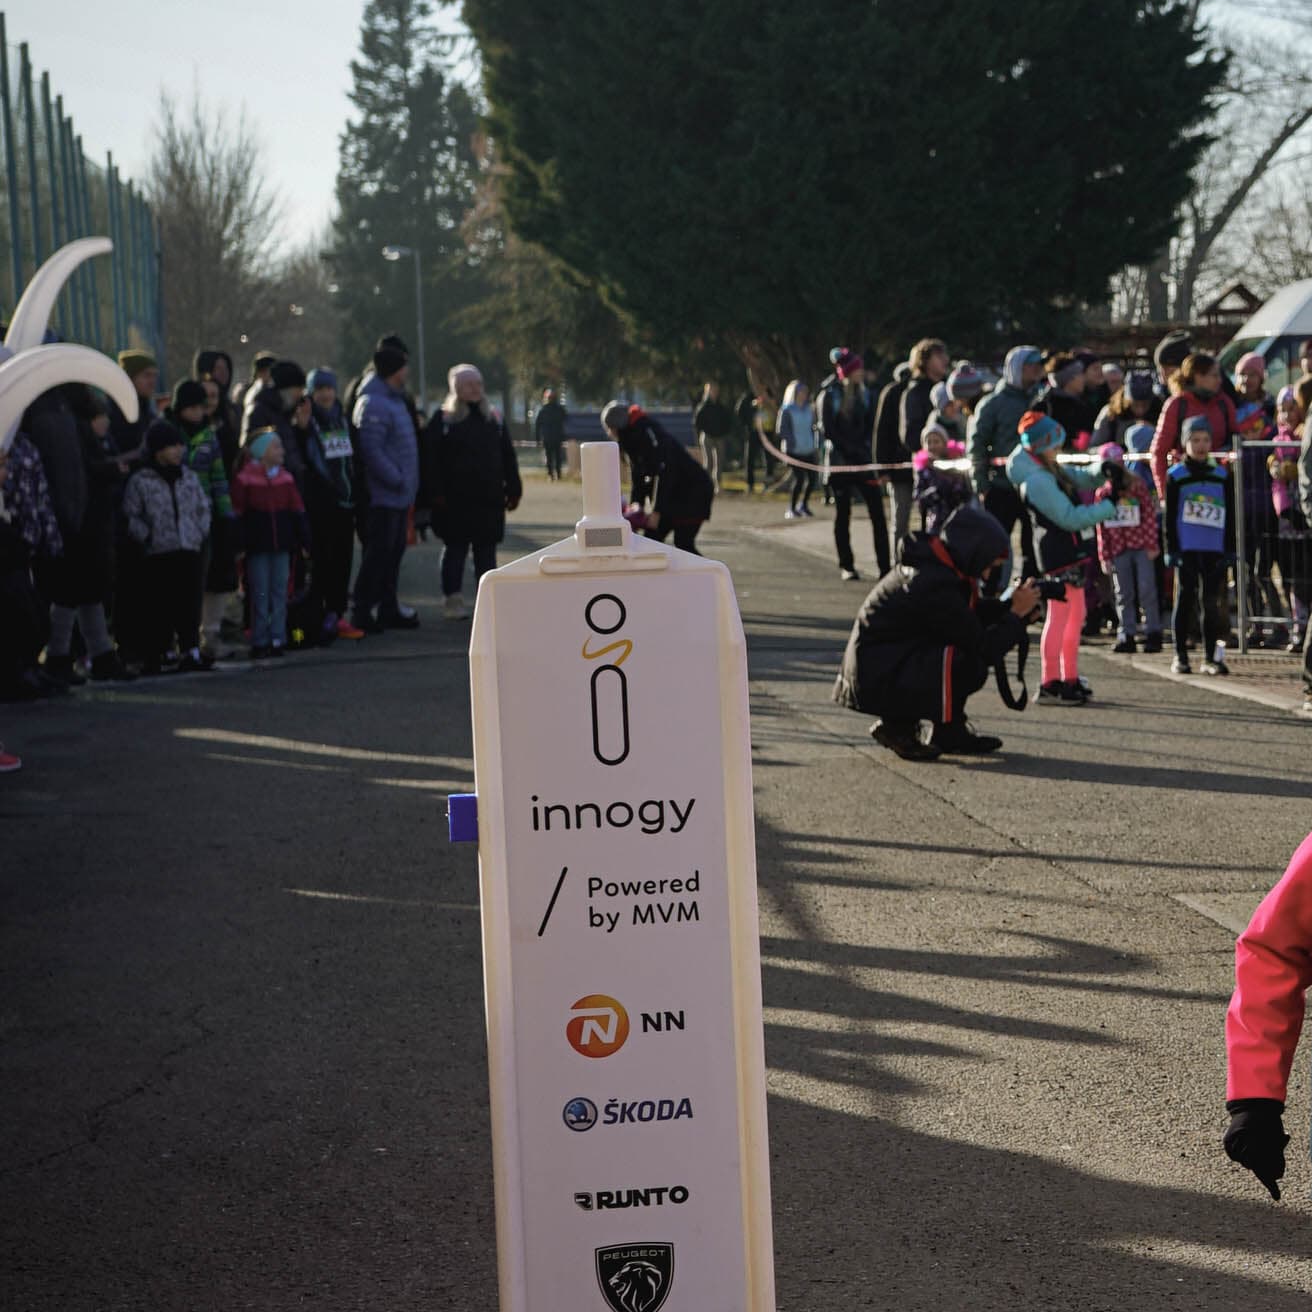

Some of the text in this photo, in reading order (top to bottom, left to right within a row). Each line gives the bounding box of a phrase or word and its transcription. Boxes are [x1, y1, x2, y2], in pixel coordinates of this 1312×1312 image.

[531, 795, 695, 835] innogy
[587, 871, 699, 898] Powered
[588, 902, 700, 930] by MVM
[640, 1010, 685, 1033] NN
[602, 1097, 694, 1125] ŠKODA
[596, 1185, 689, 1210] RUNTO
[603, 1249, 666, 1261] PEUGEOT
